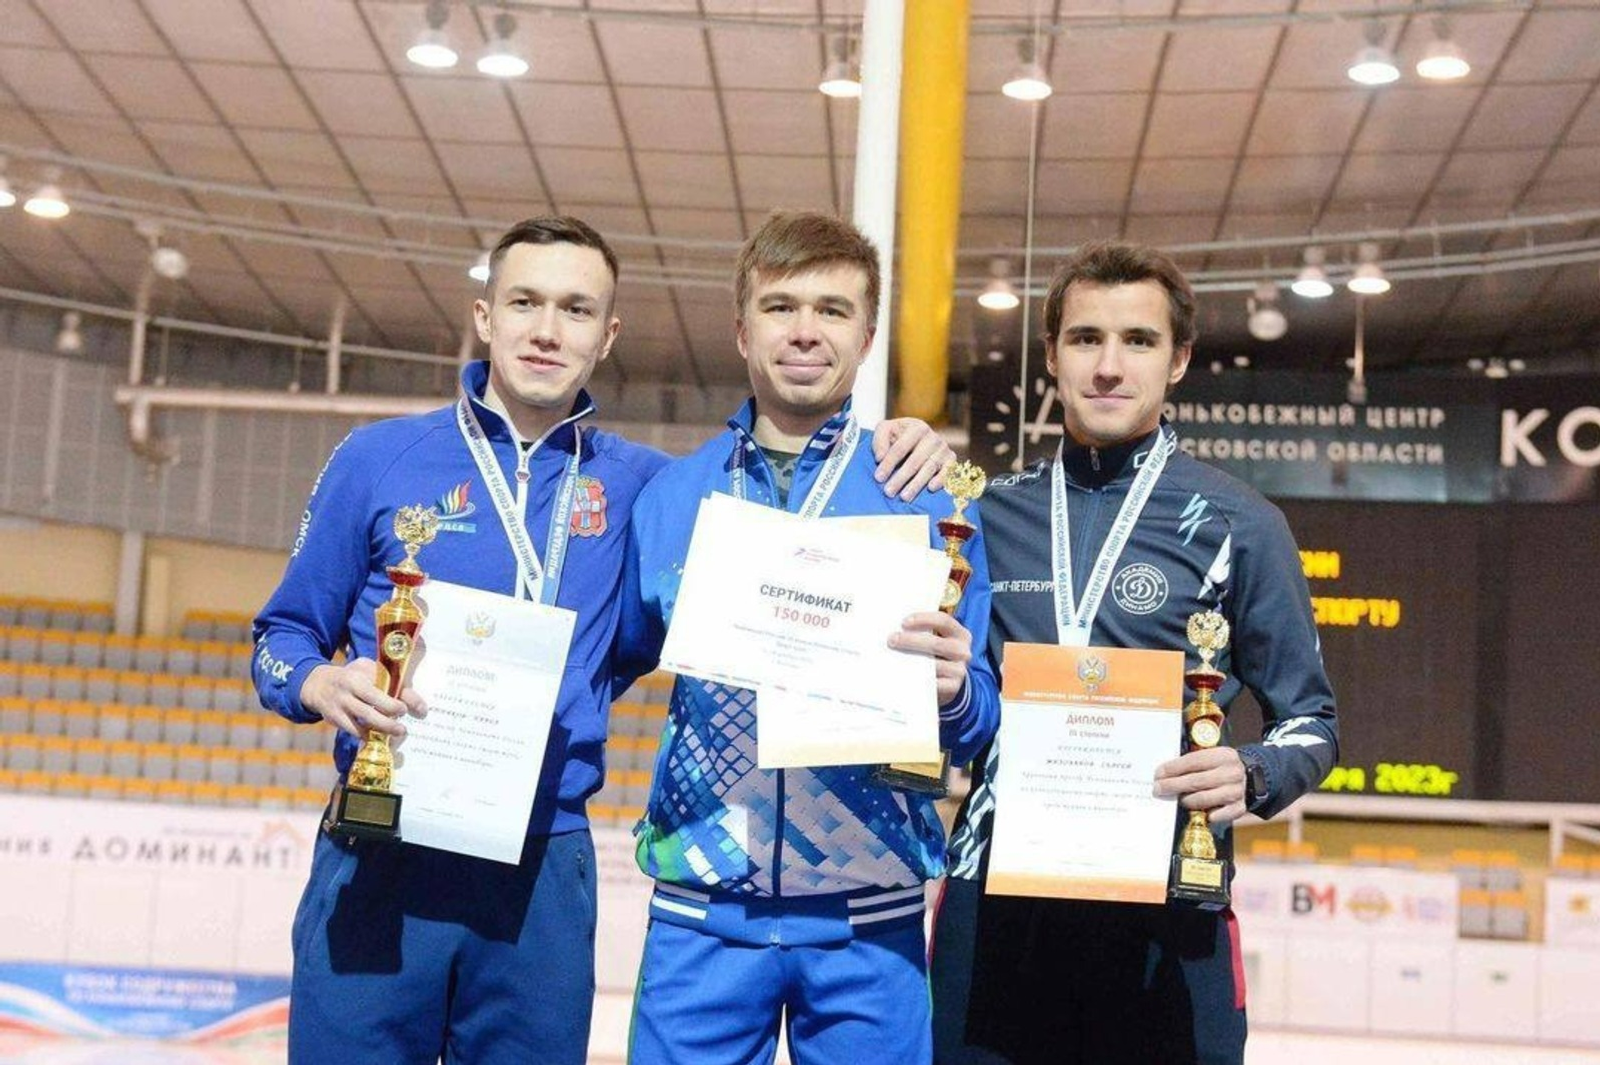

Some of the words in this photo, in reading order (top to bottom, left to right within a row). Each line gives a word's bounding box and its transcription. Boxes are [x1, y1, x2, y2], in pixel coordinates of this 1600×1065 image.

[1161, 402, 1356, 427] ОНЬКОБЕЖНЫЙ
[1366, 406, 1446, 430] ЦЕНТР
[1180, 437, 1316, 461] СКОВСКОЙ
[1327, 441, 1444, 465] ОБЛАСТИ
[1501, 406, 1600, 468] КО
[760, 584, 852, 613] СЕРТИФИКАТ
[773, 605, 799, 622] 150
[803, 612, 830, 629] 000
[1066, 713, 1115, 726] ДИПЛОМ
[74, 835, 291, 869] ДОМИНАНТ
